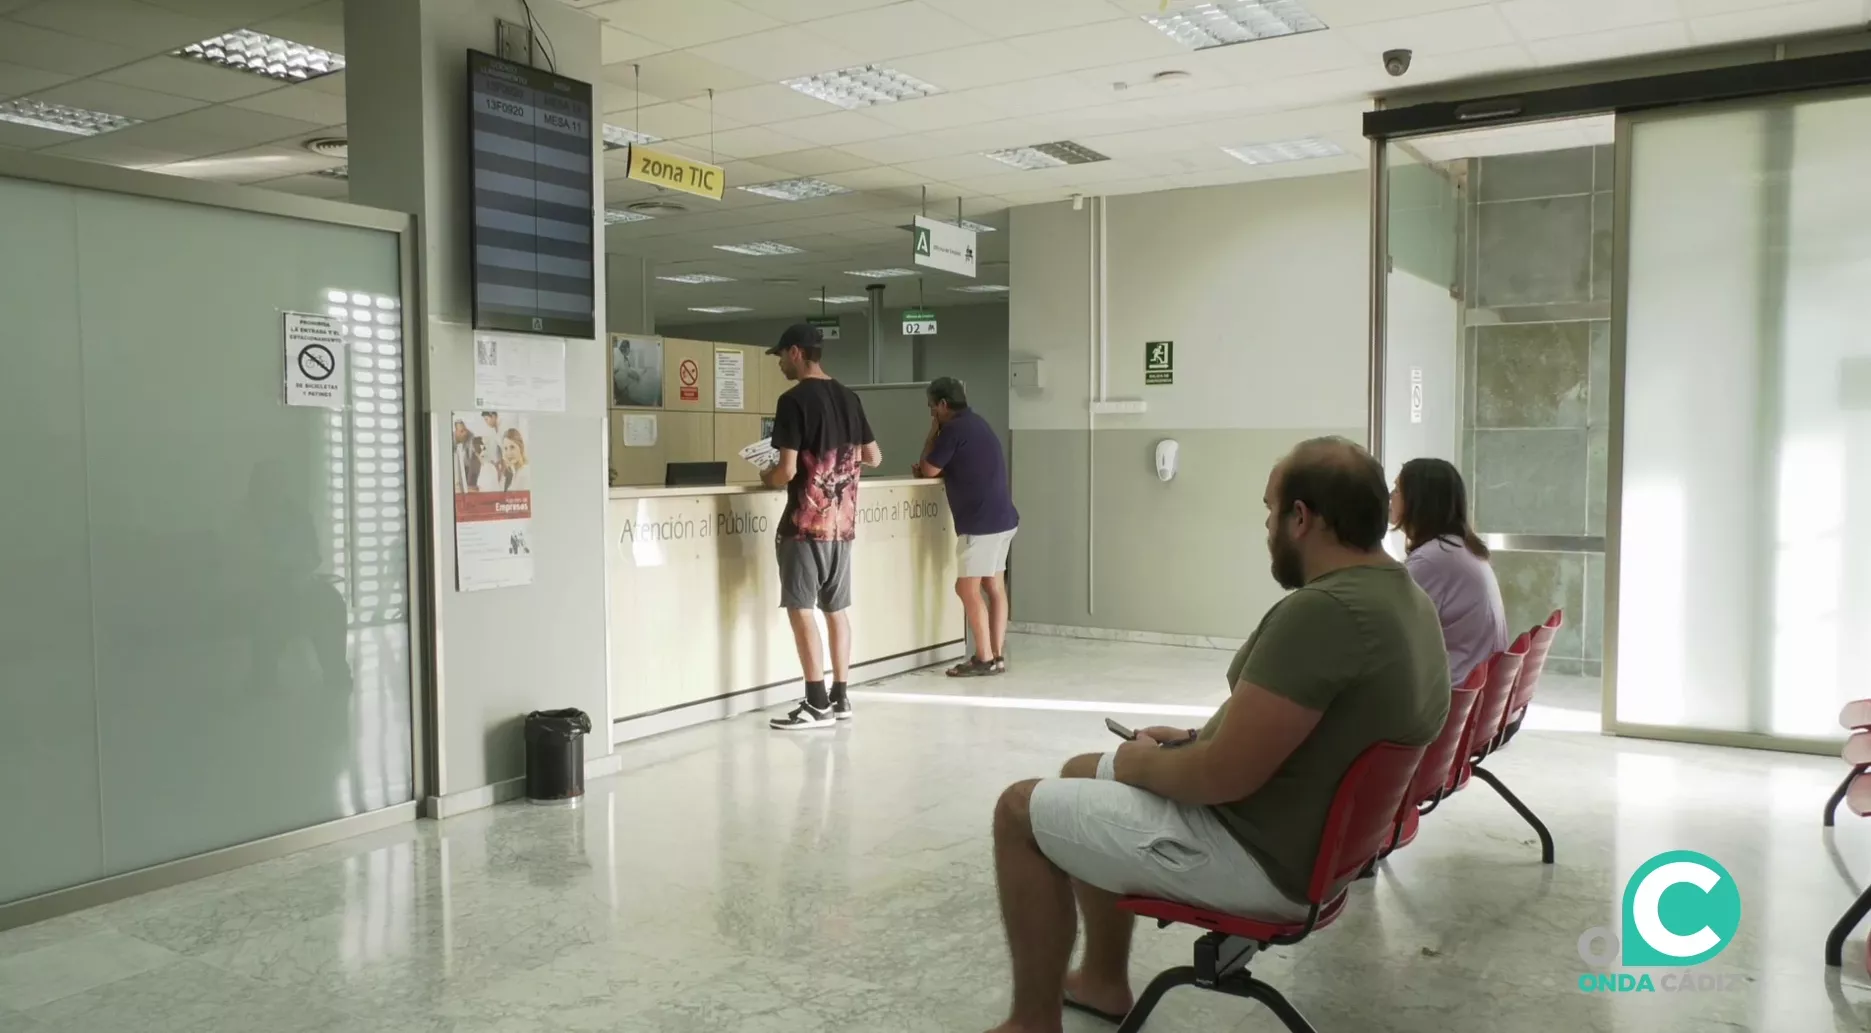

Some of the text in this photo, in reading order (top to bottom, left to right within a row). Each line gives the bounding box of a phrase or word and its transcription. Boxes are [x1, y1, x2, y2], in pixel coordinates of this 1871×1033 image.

[486, 99, 582, 132] 13F0920 MESA 11
[641, 157, 715, 191] zona TIC
[300, 327, 327, 335] ENTRADA
[906, 323, 920, 334] 02
[495, 502, 528, 513] Empresas
[891, 501, 900, 521] al
[903, 498, 938, 520] Público
[620, 511, 768, 543] Atención al Público
